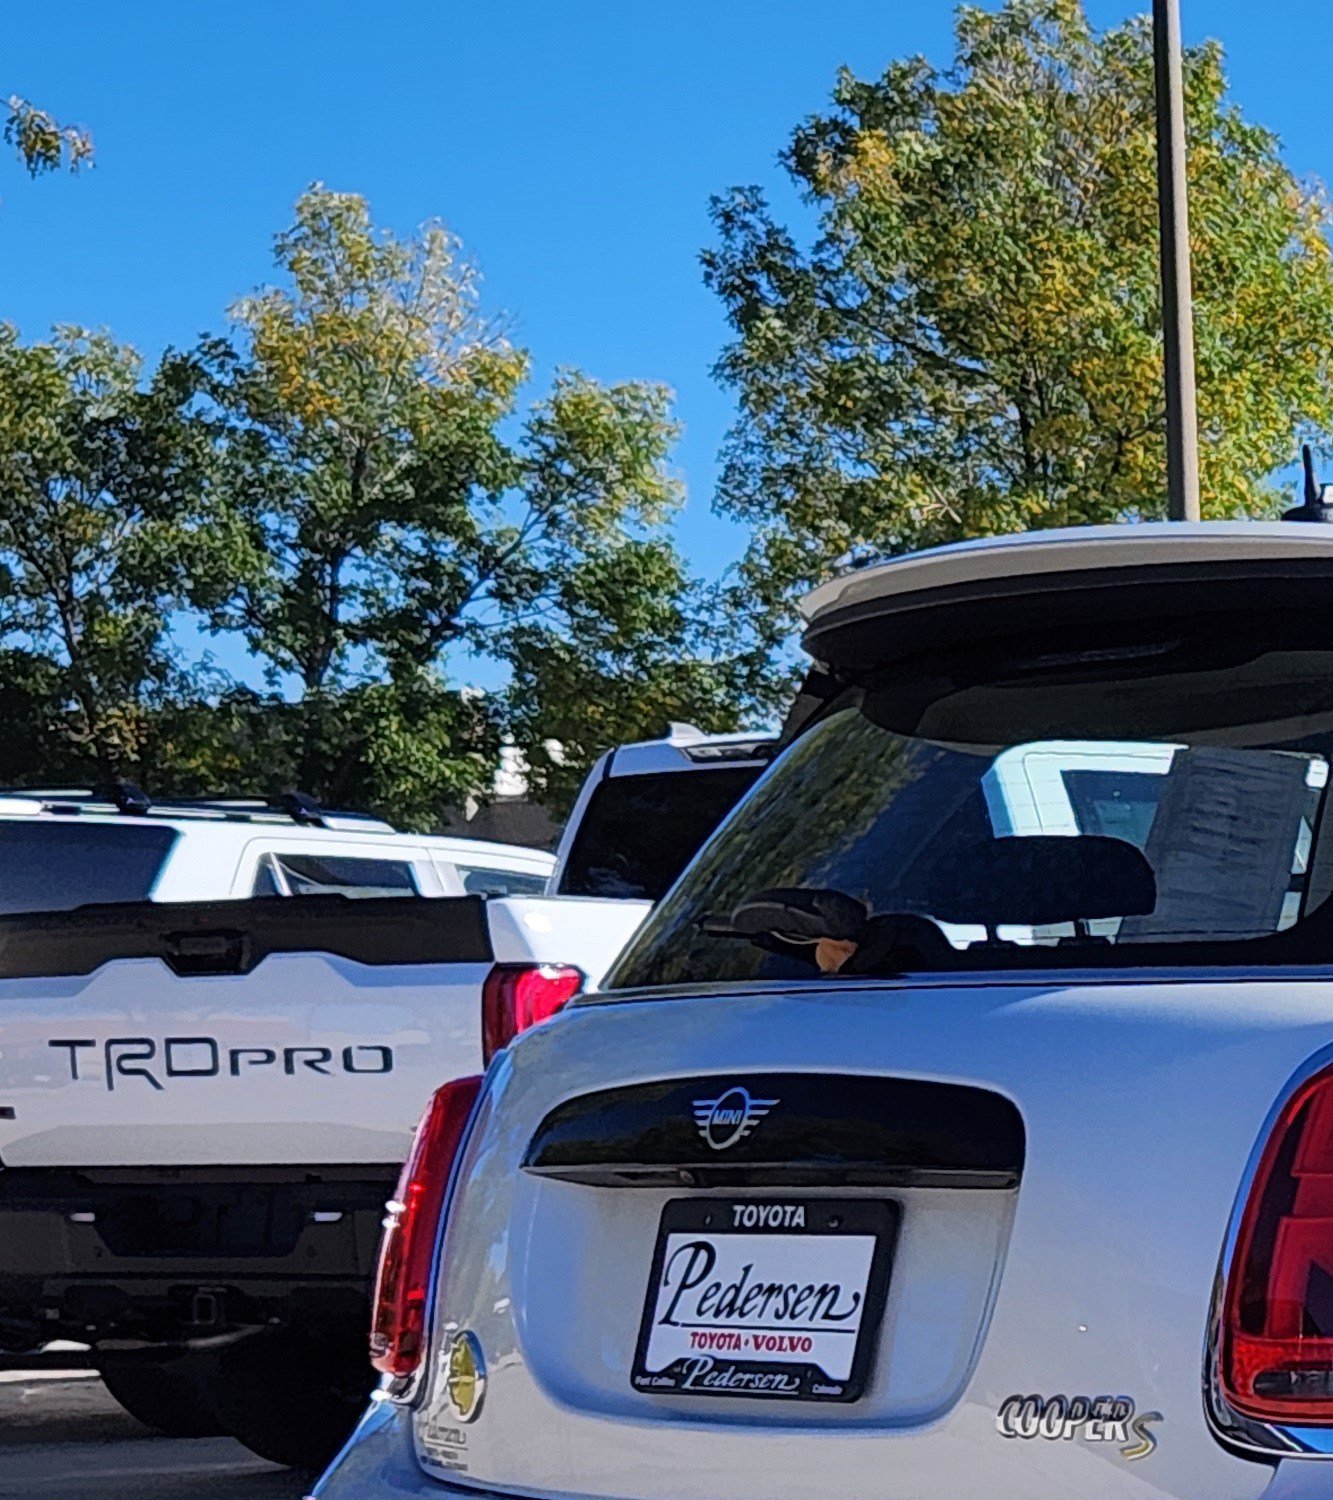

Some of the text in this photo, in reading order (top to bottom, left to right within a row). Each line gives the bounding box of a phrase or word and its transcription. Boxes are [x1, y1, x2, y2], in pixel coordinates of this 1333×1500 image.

[48, 1037, 393, 1091] TRD PRO
[712, 1109, 743, 1125] MINI
[733, 1204, 806, 1228] TOYOTA
[658, 1240, 861, 1327] Pedersen
[690, 1331, 813, 1353] TOYOTA VOLVO
[681, 1356, 800, 1390] Pedersen
[996, 1394, 1164, 1461] COOPER S
